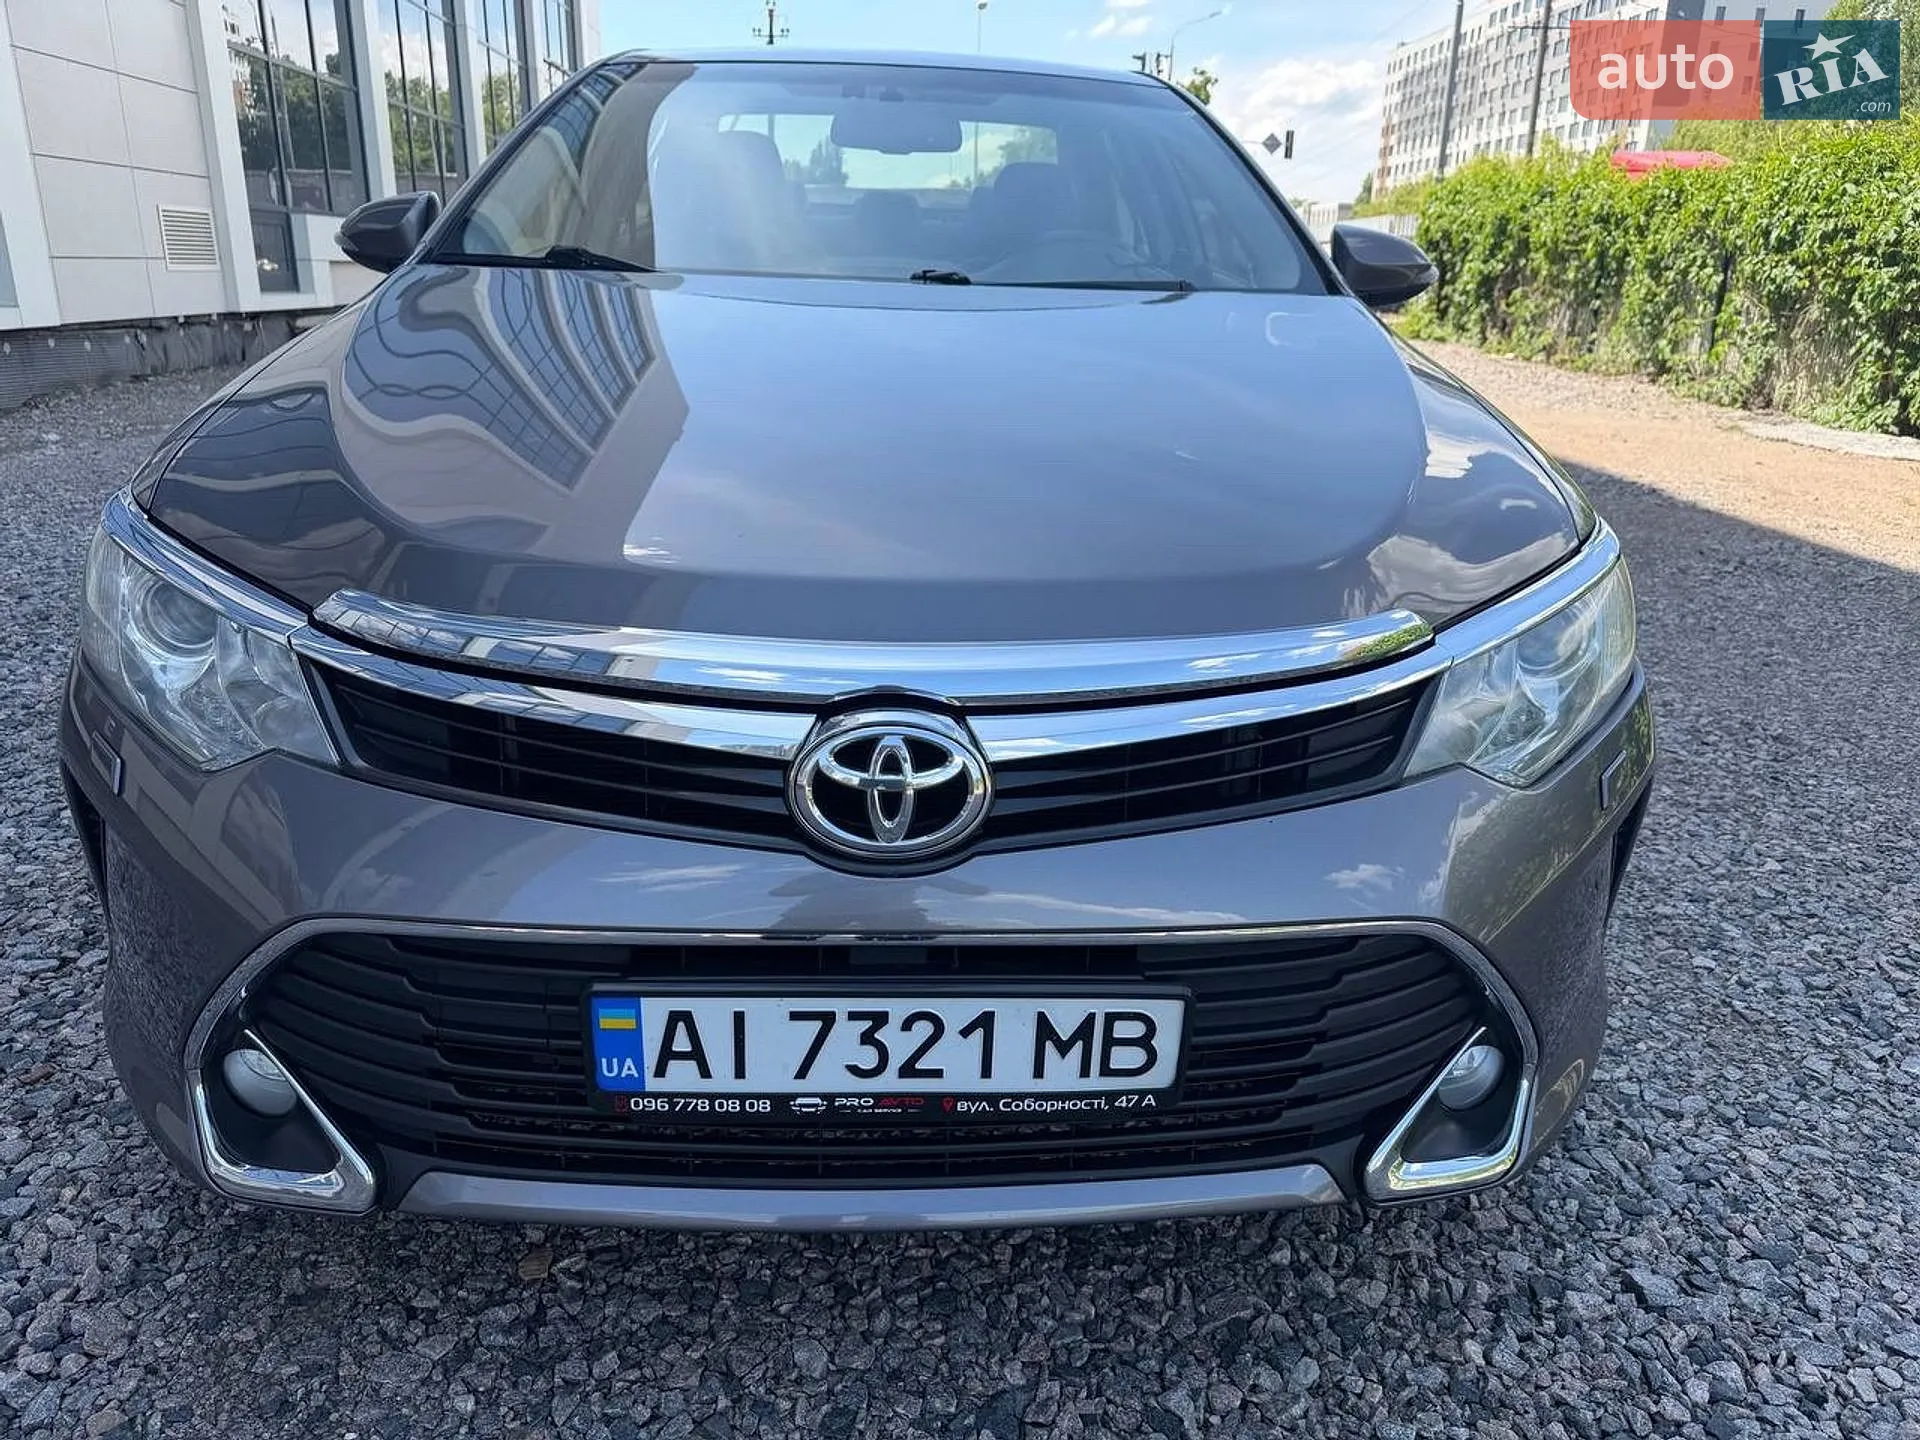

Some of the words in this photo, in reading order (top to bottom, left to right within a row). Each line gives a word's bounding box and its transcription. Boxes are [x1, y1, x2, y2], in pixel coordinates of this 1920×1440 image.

[653, 1010, 746, 1079] AI
[788, 1011, 996, 1079] 7321
[1033, 1010, 1158, 1079] MB
[601, 1057, 638, 1078] UA
[630, 1097, 669, 1112] 096
[673, 1098, 710, 1112] 778
[715, 1099, 740, 1112] 08
[745, 1099, 771, 1112] 08
[834, 1097, 874, 1107] PRO
[957, 1100, 994, 1114] вул.
[999, 1096, 1109, 1113] Соборності,
[1114, 1095, 1139, 1108] 47
[1141, 1094, 1156, 1107] А
